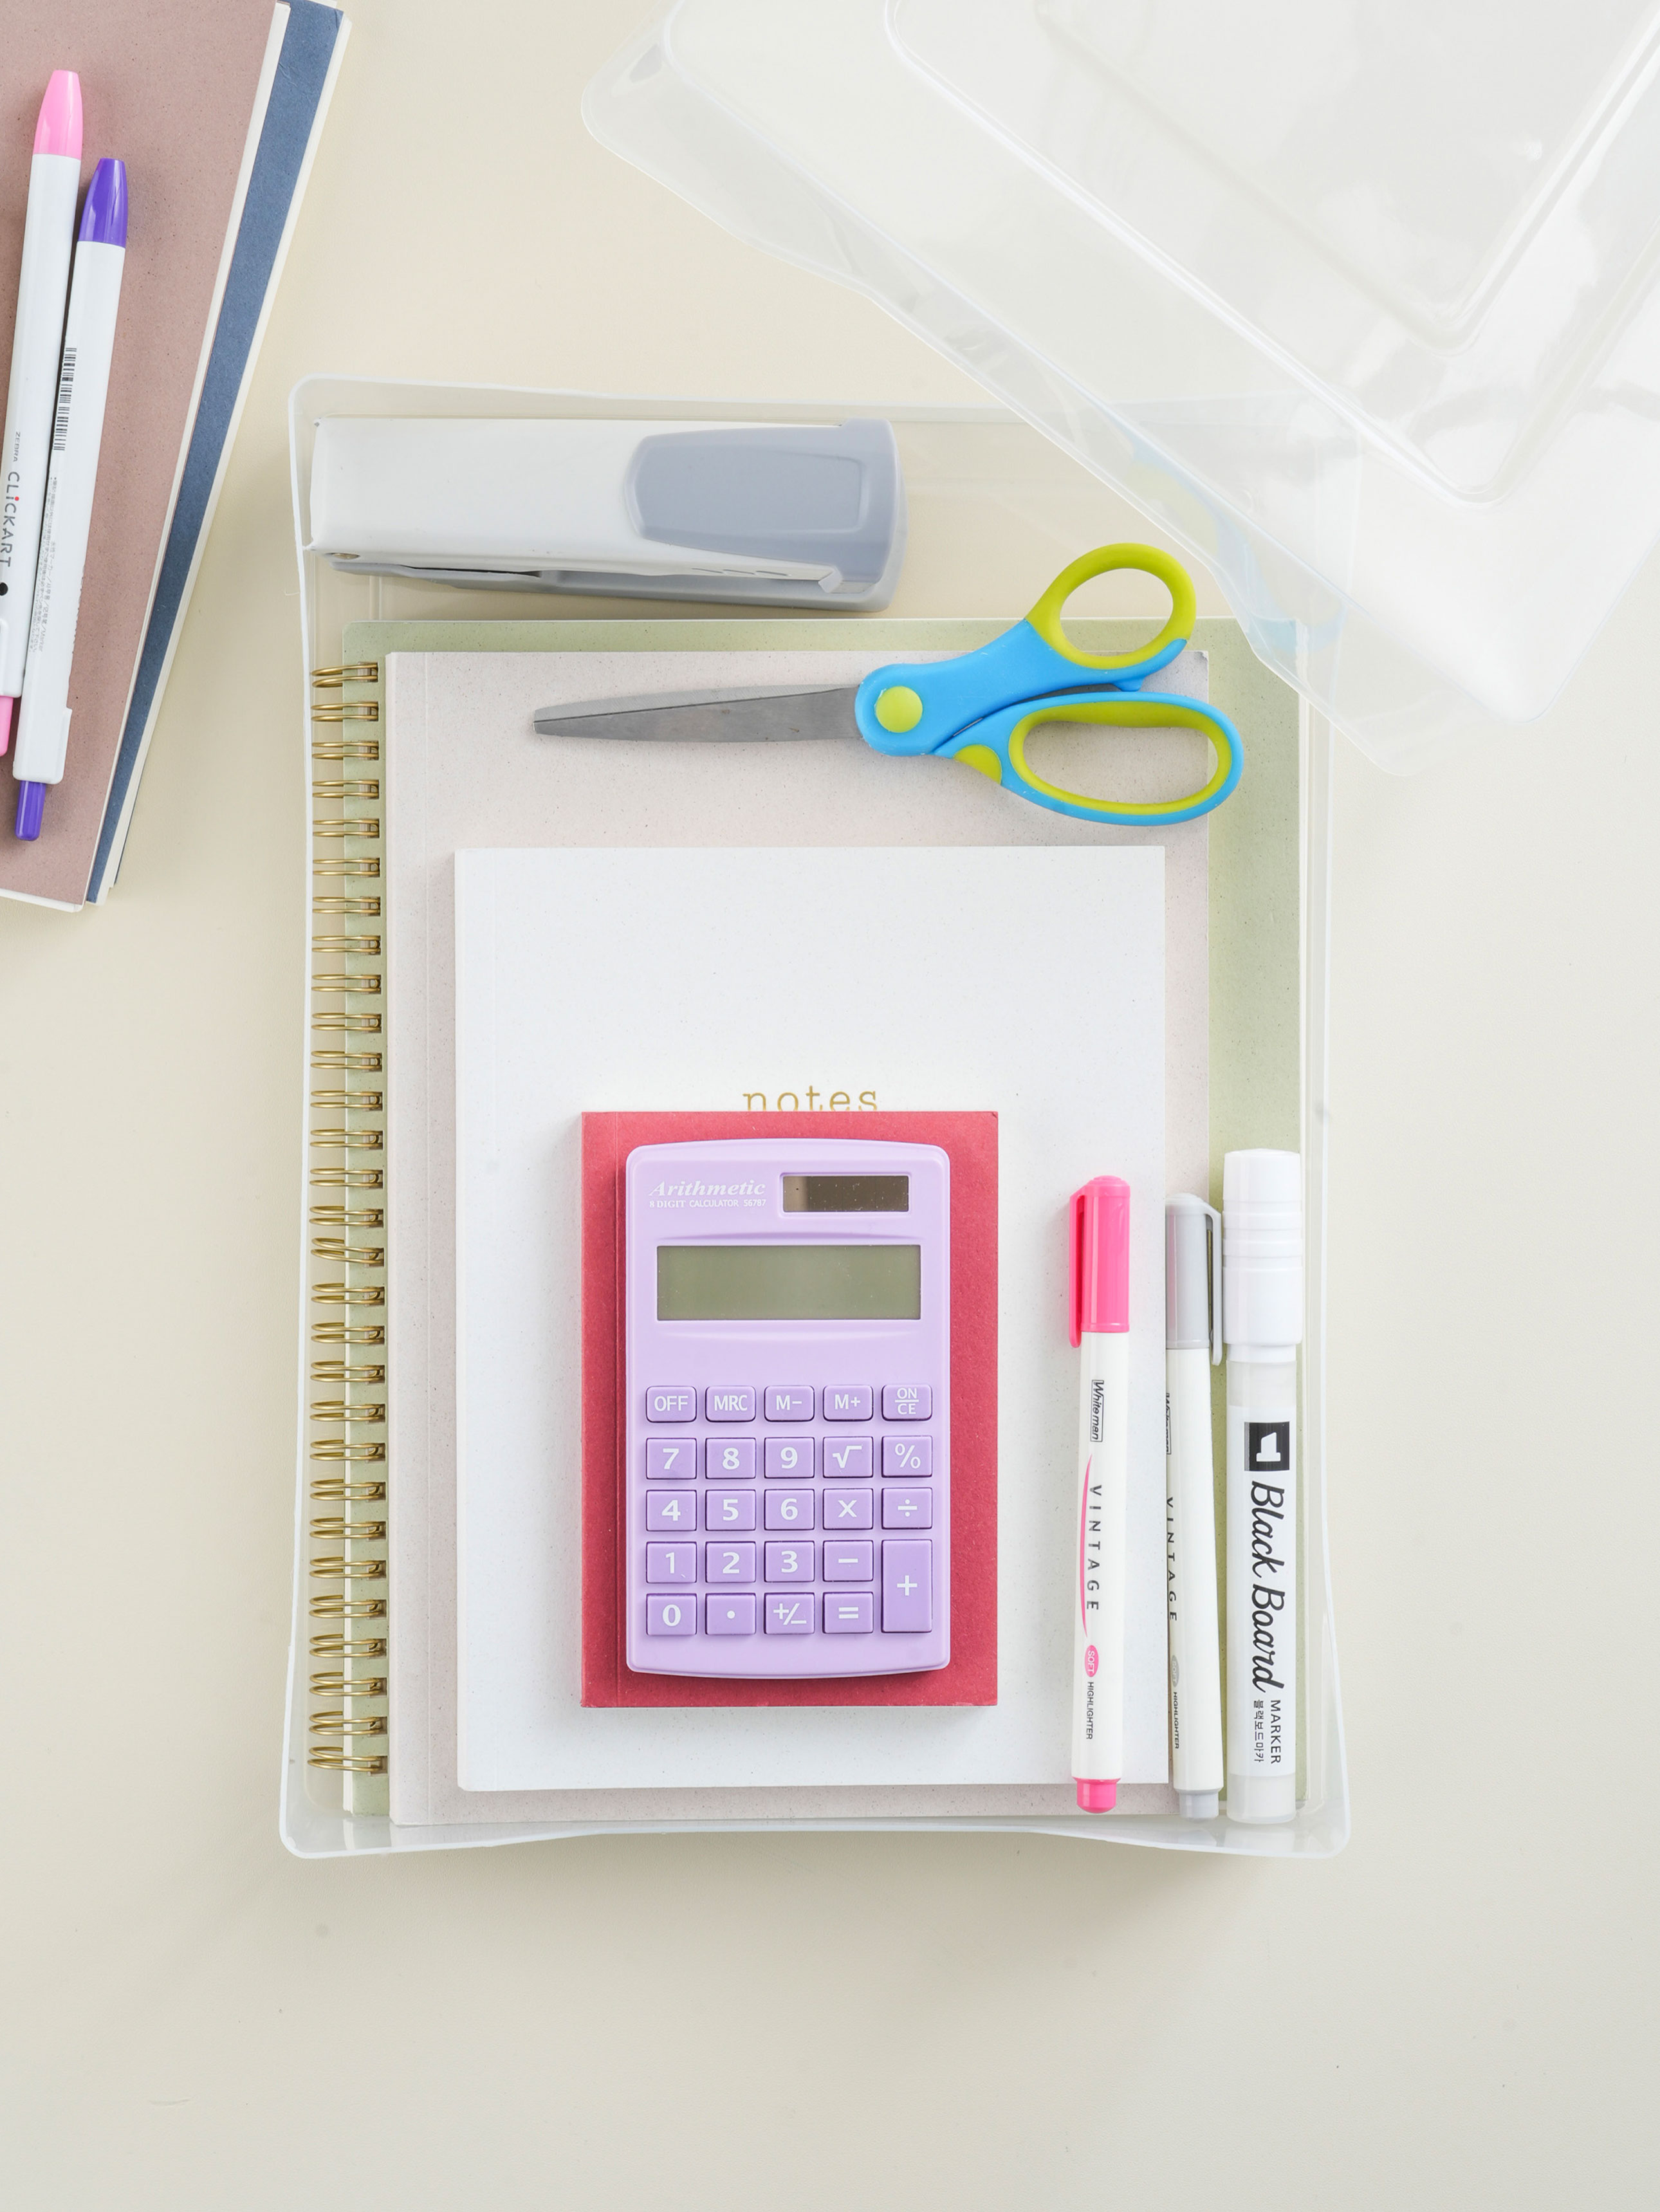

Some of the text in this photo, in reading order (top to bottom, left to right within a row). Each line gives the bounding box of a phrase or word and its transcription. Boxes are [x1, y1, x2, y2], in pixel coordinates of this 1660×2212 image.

[742, 1085, 878, 1112] notes
[648, 1179, 766, 1196] Arithmetic
[689, 1199, 739, 1208] CALCULATOR
[654, 1396, 688, 1412] OFF
[714, 1395, 748, 1411] MRC
[835, 1394, 861, 1410] M+
[897, 1388, 917, 1399] ON
[898, 1403, 916, 1415] CE
[663, 1448, 679, 1470] 7
[722, 1448, 740, 1470] 8
[780, 1447, 798, 1469] 9
[895, 1443, 921, 1469] %
[661, 1500, 681, 1521] 4
[723, 1498, 739, 1521] 5
[780, 1498, 798, 1520] 6
[1087, 1485, 1102, 1610] VINTAGE
[1166, 1497, 1177, 1621] VINTAGE
[665, 1552, 675, 1574] 1
[723, 1552, 740, 1574] 2
[781, 1551, 798, 1572] 3
[1251, 1480, 1286, 1693] Black Board
[663, 1604, 681, 1627] 0
[1086, 1681, 1094, 1740] HIGHLIGHTER
[1253, 1699, 1264, 1763] 블랙보드마카
[1270, 1700, 1281, 1764] MARKER
